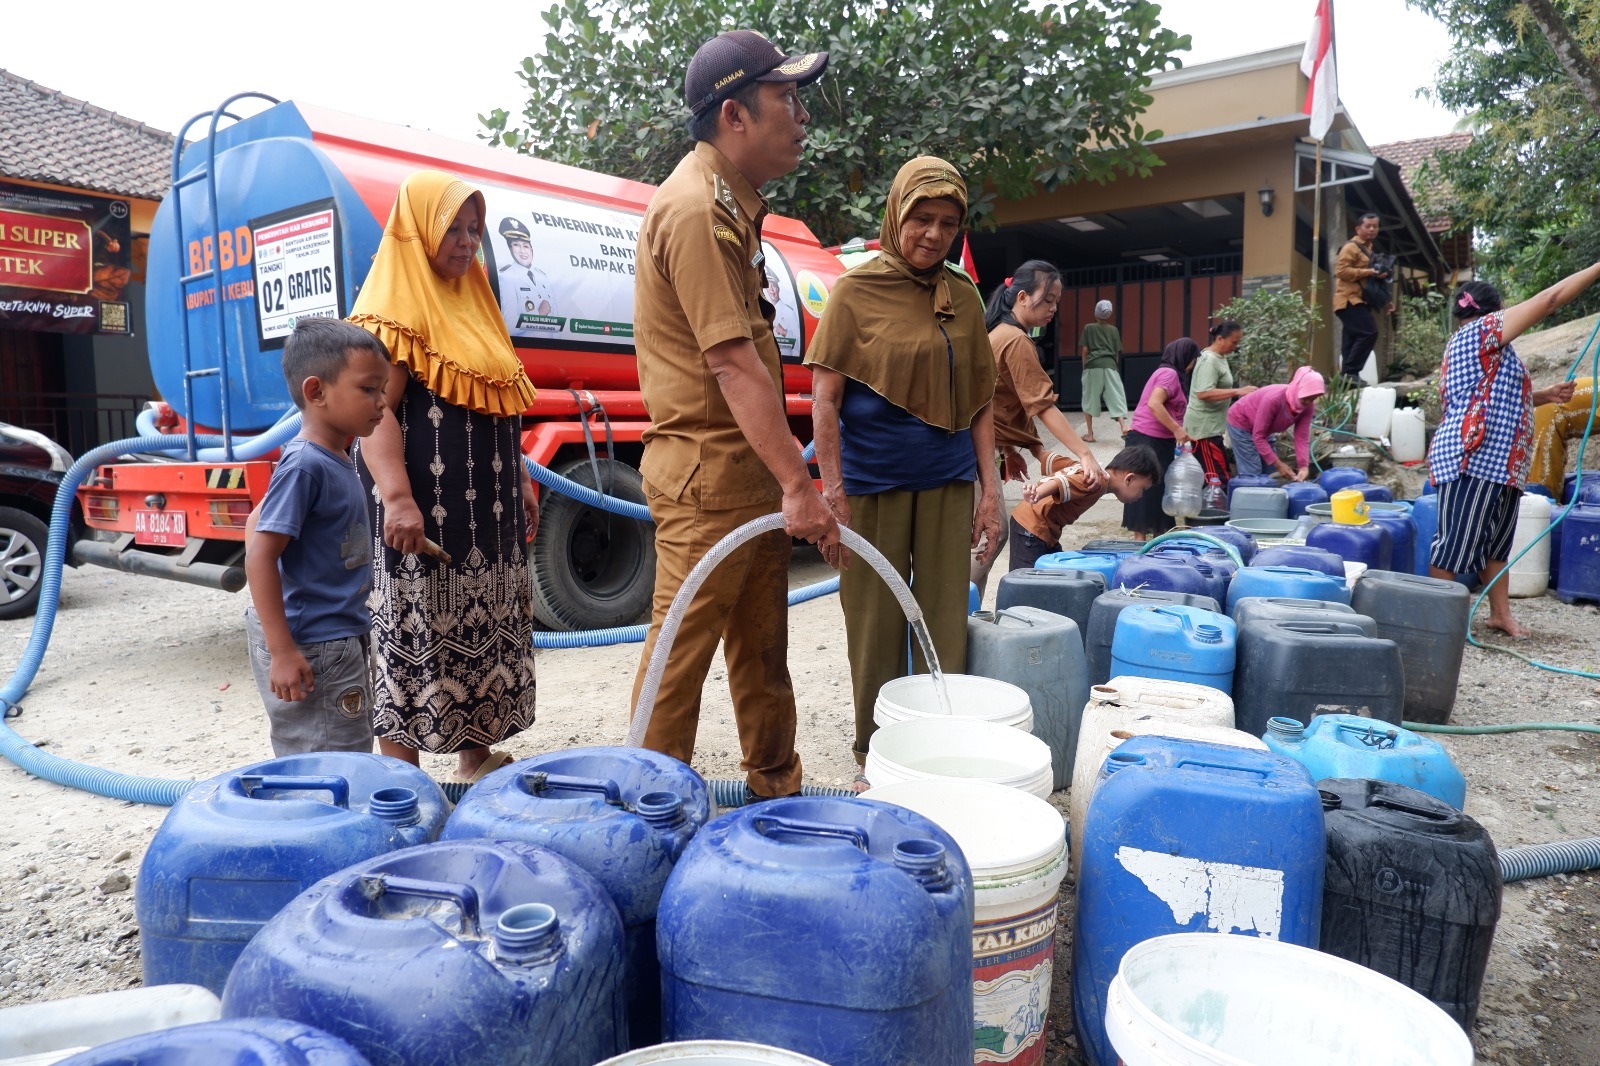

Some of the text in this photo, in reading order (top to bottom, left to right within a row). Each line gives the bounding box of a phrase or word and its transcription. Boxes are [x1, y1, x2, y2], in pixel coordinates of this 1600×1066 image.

[714, 68, 745, 90] SARMAN
[112, 205, 126, 214] 21+
[258, 217, 328, 240] PEMERINTAH KAB KEBUMEN
[531, 211, 624, 239] PEMERINTAH
[10, 225, 82, 250] SUPER
[0, 256, 45, 276] TEK
[260, 262, 282, 275] TANGKI
[569, 254, 626, 275] DAMPAK
[228, 279, 255, 301] KEBU
[288, 265, 332, 301] GRATIS
[262, 277, 285, 314] 02
[53, 304, 95, 318] SUPER
[135, 513, 184, 534] AA 8184 XD
[972, 931, 1012, 951] YAL
